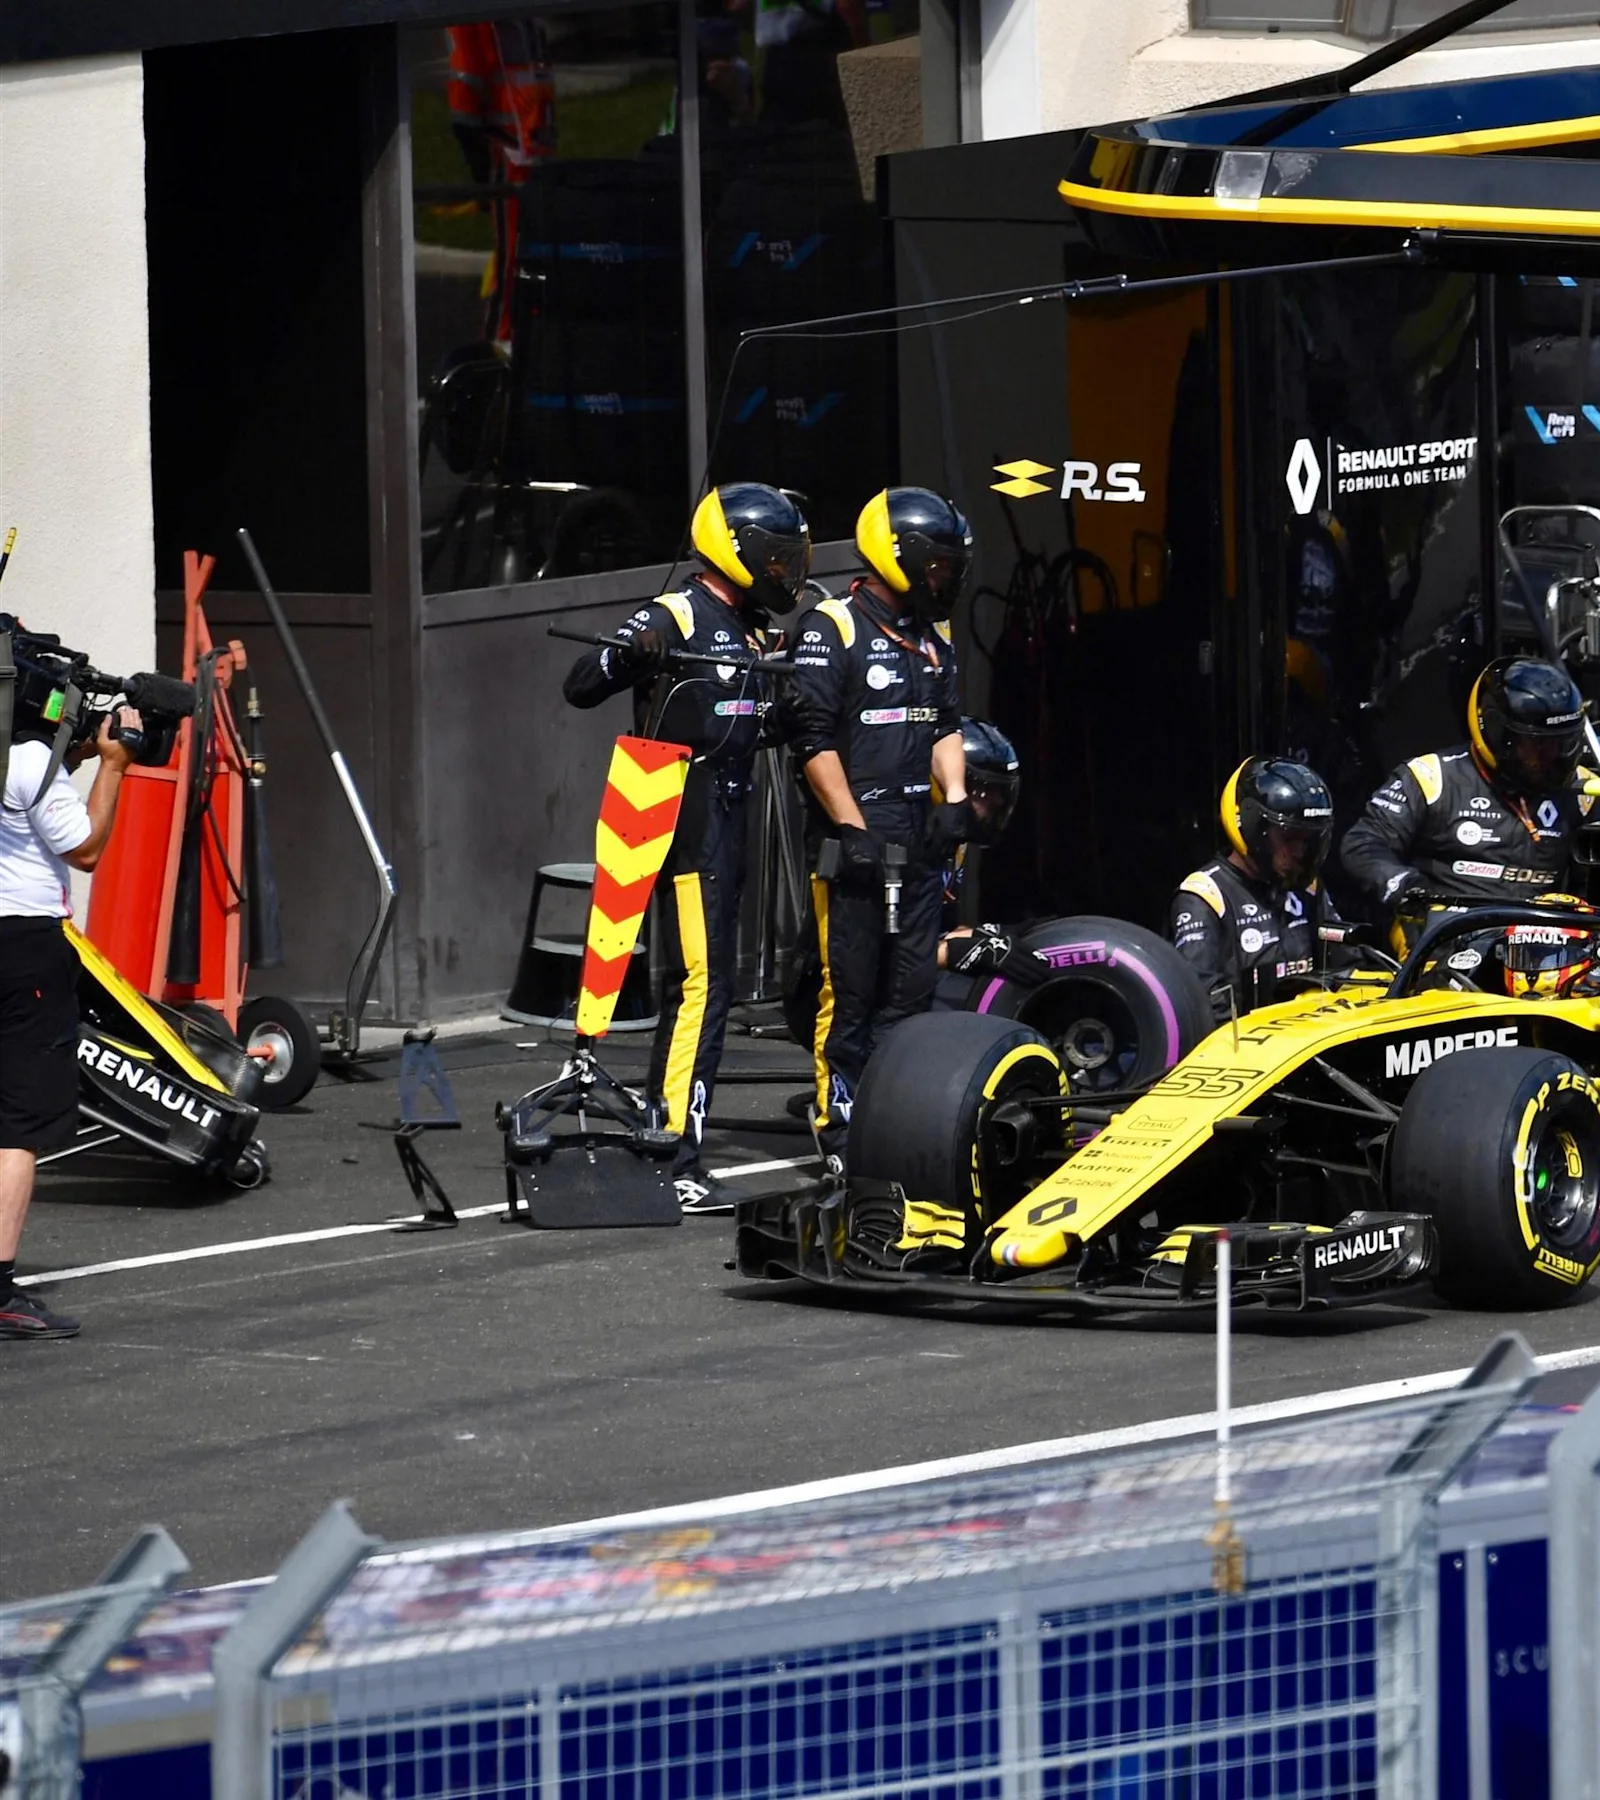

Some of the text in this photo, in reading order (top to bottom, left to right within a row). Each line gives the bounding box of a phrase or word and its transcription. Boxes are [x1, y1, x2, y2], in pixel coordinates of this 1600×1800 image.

[1338, 437, 1478, 474] RENAULT SPORT
[1060, 460, 1146, 503] R.S.
[1338, 465, 1467, 494] FORMULA ONE TEAM
[1465, 864, 1500, 878] Castrol
[1509, 933, 1571, 946] RENAULT
[77, 1038, 223, 1128] RENAULT
[1147, 1065, 1265, 1099] 55
[1537, 1081, 1551, 1112] P
[1069, 1162, 1137, 1174] MAPFRE
[1315, 1226, 1405, 1269] RENAULT
[1495, 1645, 1550, 1677] SCU
